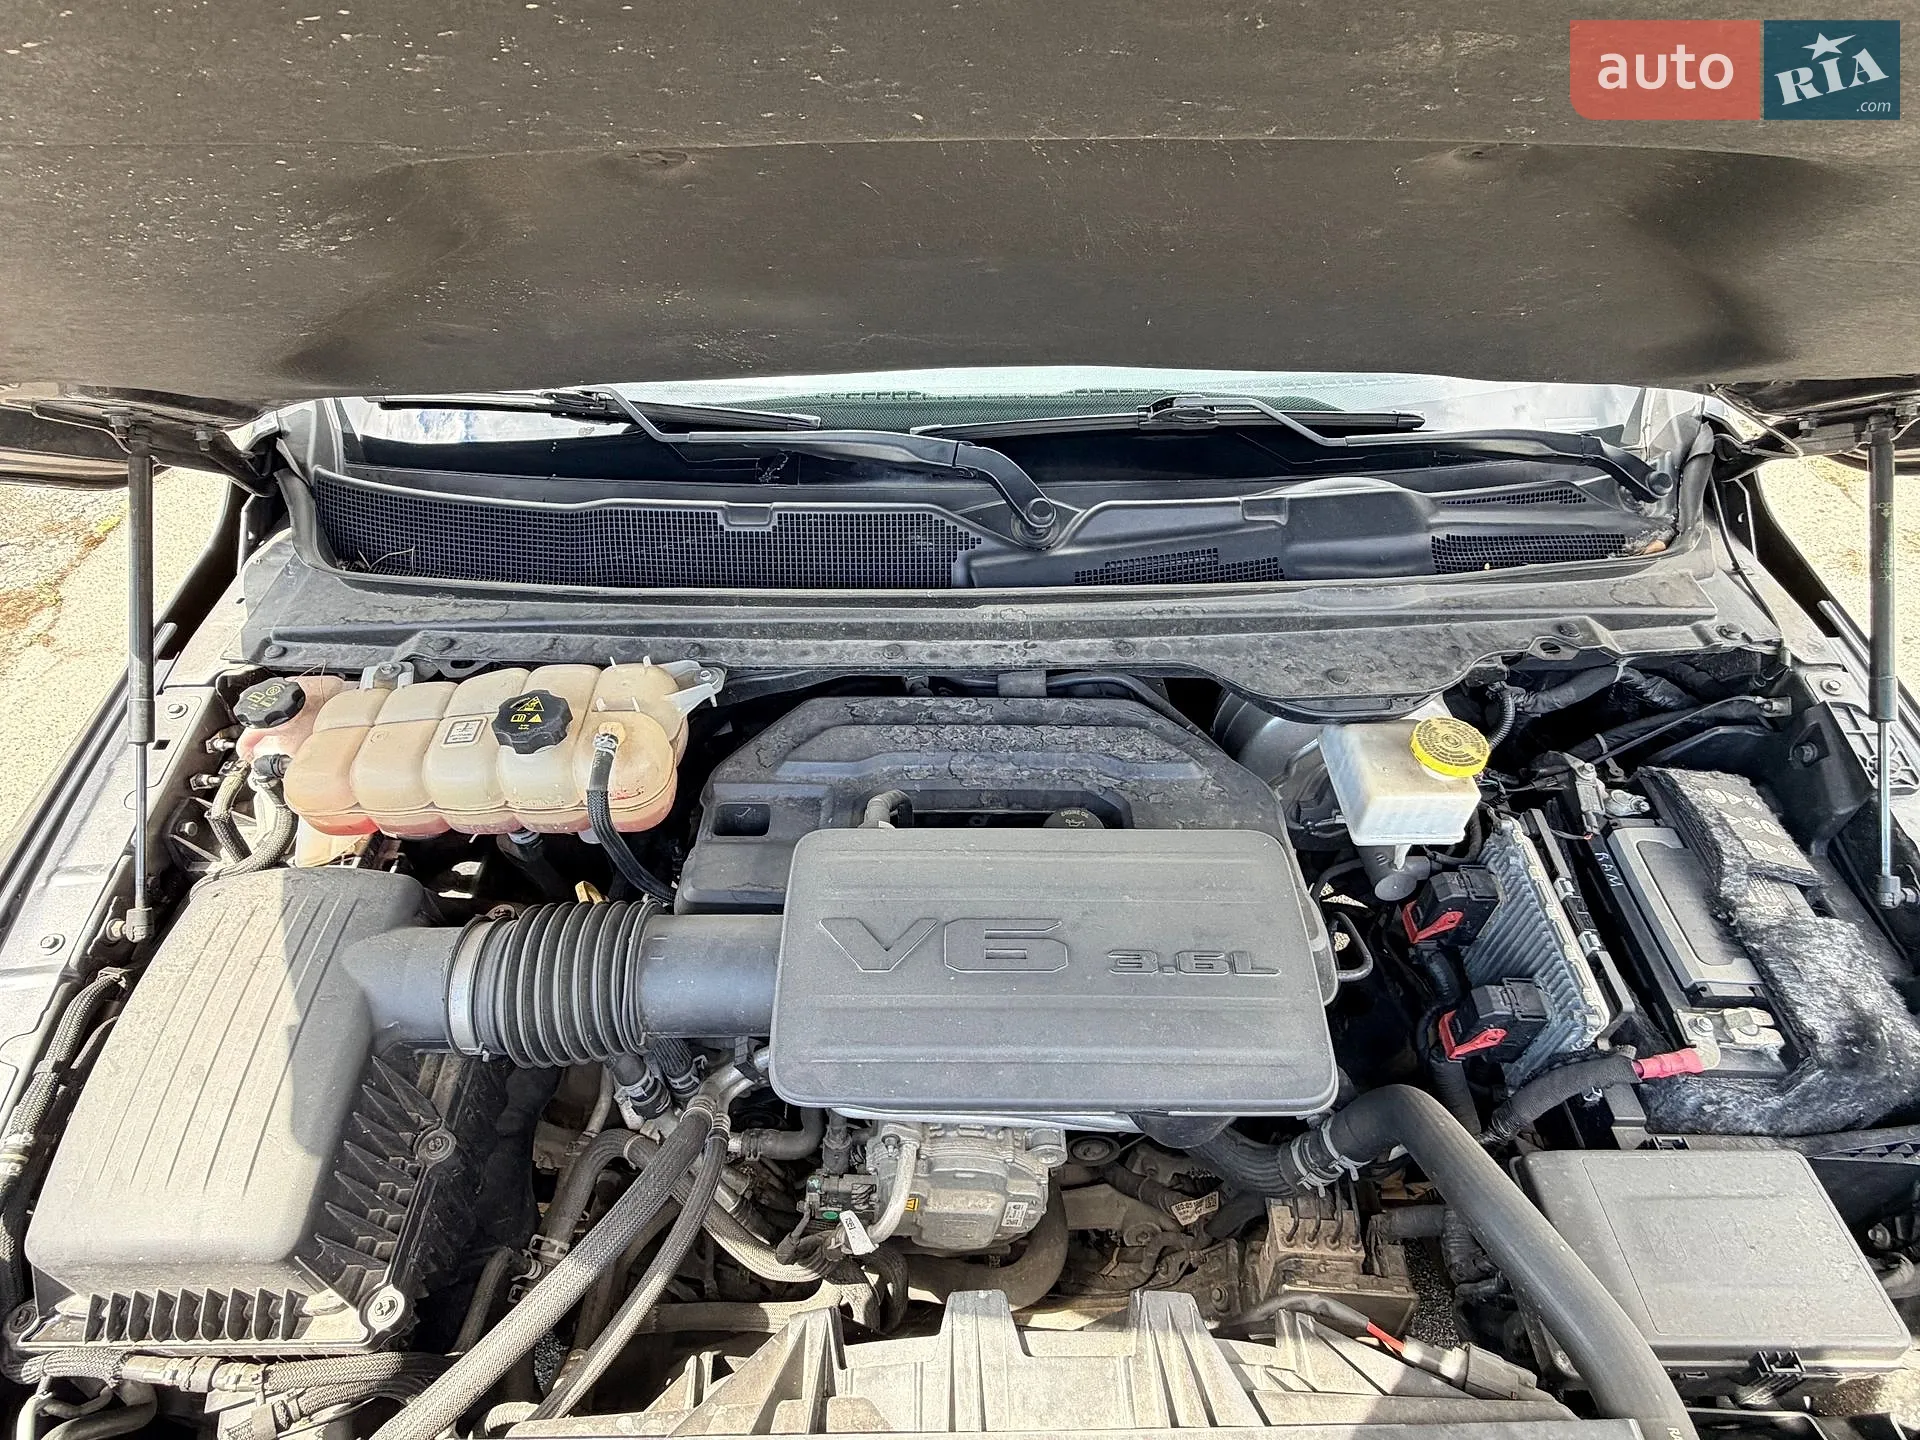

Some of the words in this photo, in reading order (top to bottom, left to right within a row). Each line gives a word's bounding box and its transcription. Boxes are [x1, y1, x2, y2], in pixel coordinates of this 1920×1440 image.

[1594, 852, 1624, 887] RAM
[819, 917, 1069, 974] V6
[1107, 949, 1281, 976] 3.6L
